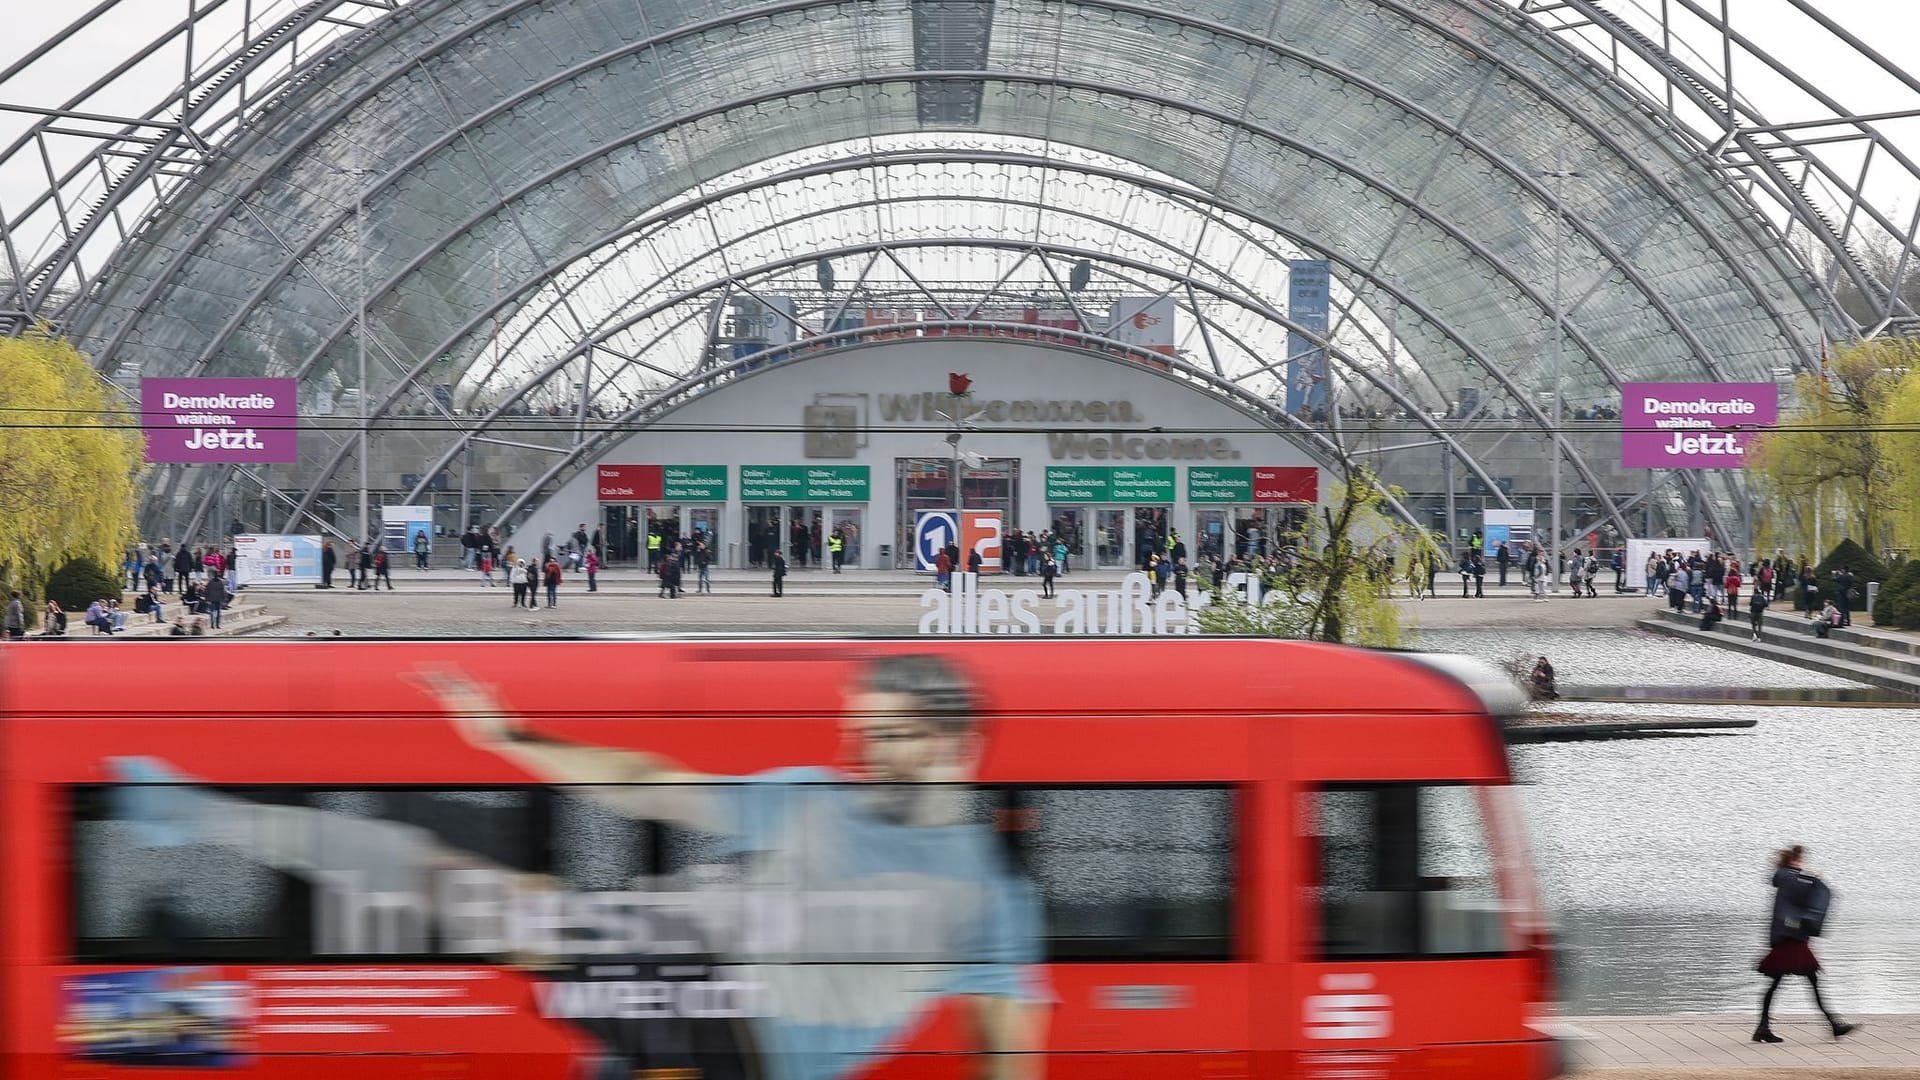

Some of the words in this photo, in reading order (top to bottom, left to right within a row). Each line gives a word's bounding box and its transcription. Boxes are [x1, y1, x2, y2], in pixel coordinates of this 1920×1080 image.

[163, 393, 276, 409] Demokratie
[1643, 397, 1756, 414] Demokratie
[174, 411, 237, 425] wählen.
[184, 429, 265, 450] Jetzt.
[1047, 431, 1242, 461] Welcome.
[1664, 432, 1744, 455] Jetzt.
[918, 571, 1041, 634] alles
